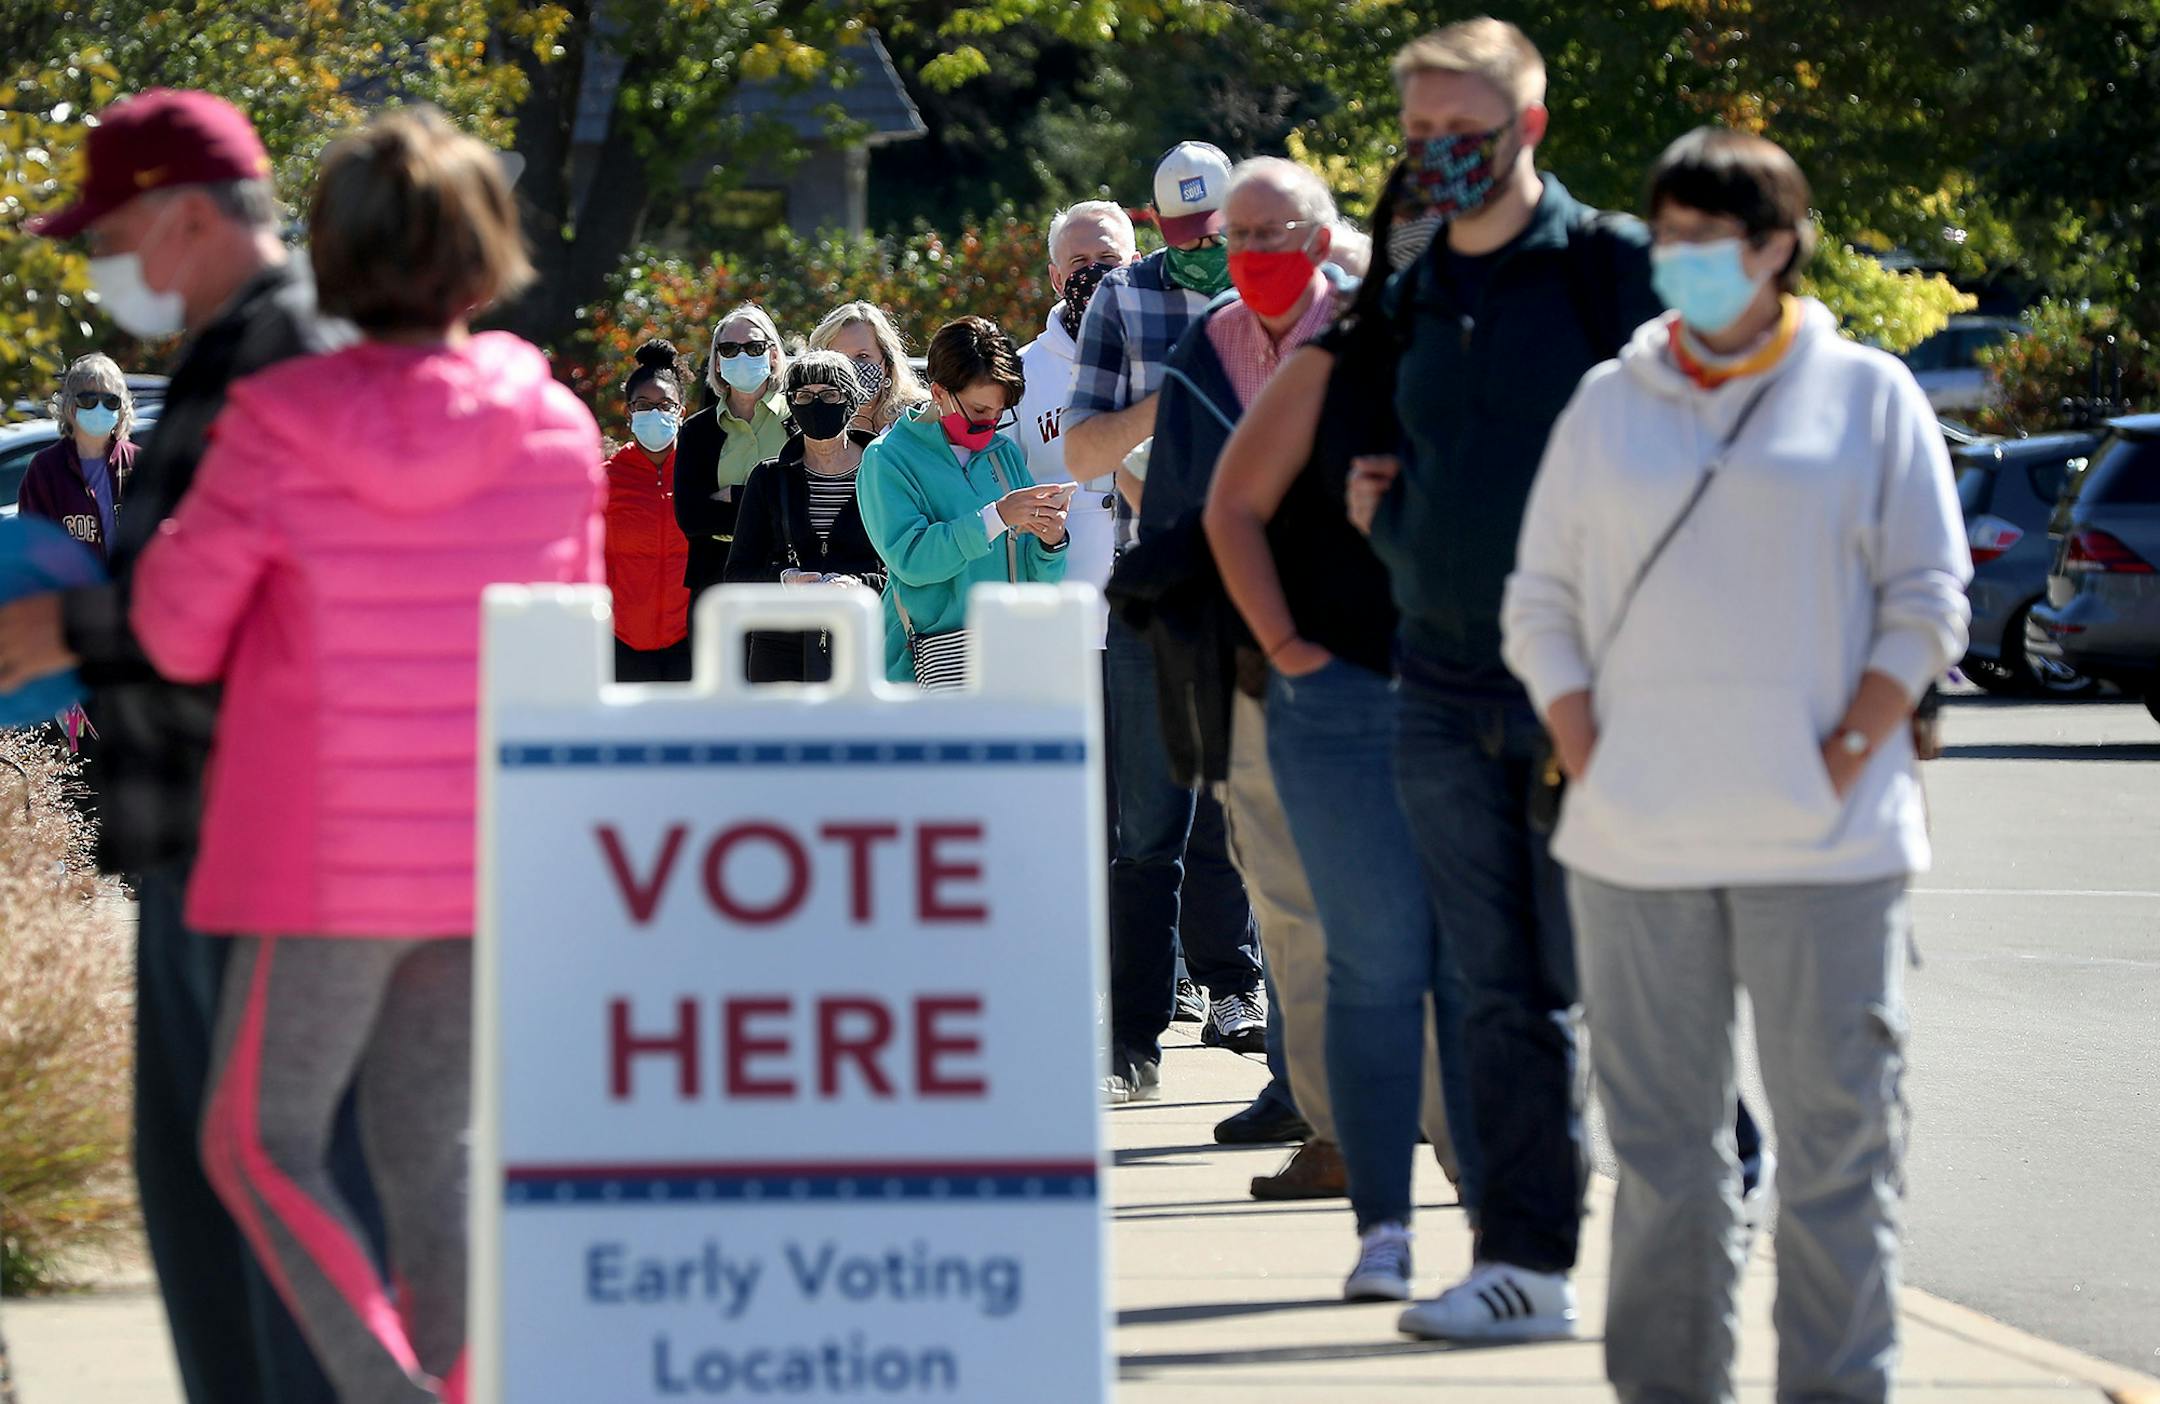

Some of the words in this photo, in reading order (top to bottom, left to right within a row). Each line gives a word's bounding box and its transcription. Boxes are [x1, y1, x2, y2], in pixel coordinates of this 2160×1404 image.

[62, 514, 101, 543] GOP
[594, 820, 990, 927] VOTE
[609, 995, 989, 1099] HERE
[584, 1240, 765, 1321] Early
[783, 1239, 1022, 1319] Voting
[653, 1330, 959, 1394] Location
